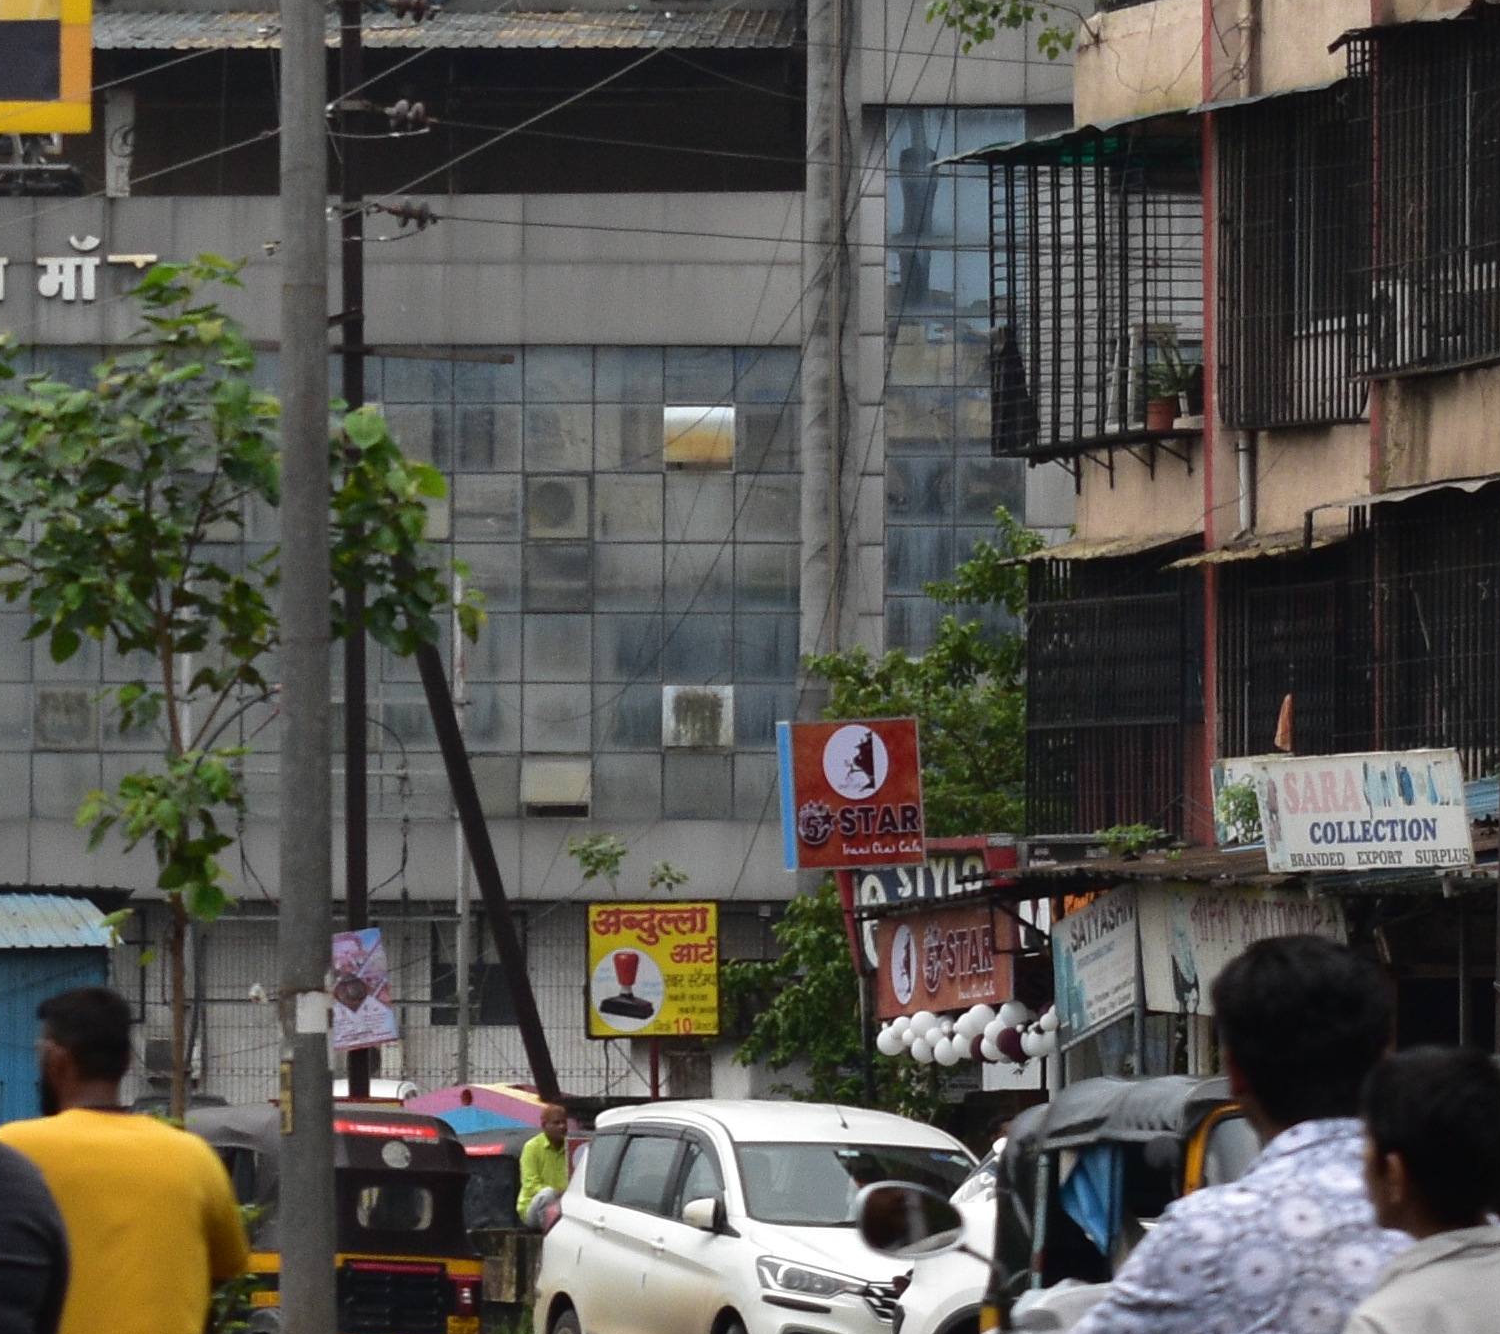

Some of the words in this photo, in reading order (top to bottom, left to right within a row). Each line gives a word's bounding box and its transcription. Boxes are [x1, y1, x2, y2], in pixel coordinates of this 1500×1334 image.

[1284, 770, 1362, 815] SARA
[838, 803, 920, 836] STAR
[1309, 817, 1438, 845] COLLECTION
[1289, 851, 1346, 867] BRANDED
[1356, 850, 1403, 866] EXPORT
[1414, 848, 1471, 864] SURPLUS
[592, 907, 710, 946] अब्दुल्ला
[669, 936, 716, 965] आर्ट
